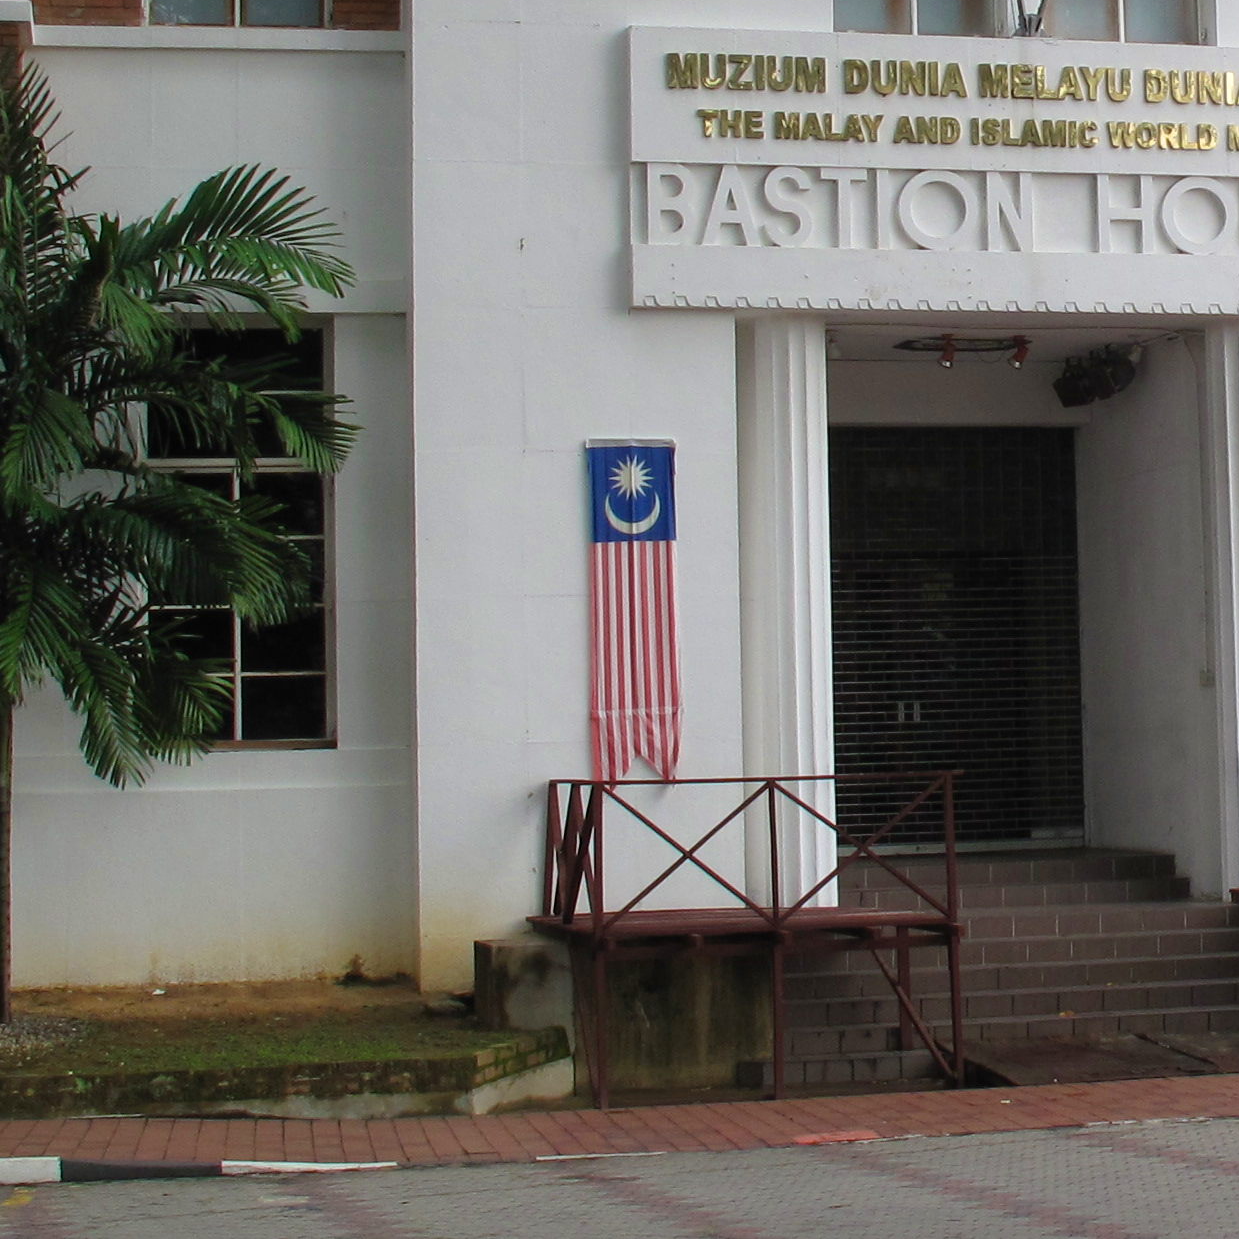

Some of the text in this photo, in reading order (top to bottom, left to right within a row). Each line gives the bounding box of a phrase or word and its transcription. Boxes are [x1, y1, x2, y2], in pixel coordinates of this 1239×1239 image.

[667, 53, 827, 93] MUZIUM
[844, 59, 967, 98] DUNIA
[979, 63, 1131, 101] MELAYU
[697, 108, 764, 139] THE
[775, 111, 884, 143] MALAY
[894, 115, 961, 145] AND
[971, 117, 1098, 148] ISLAMIC
[1107, 121, 1218, 151] WORLD
[647, 162, 1034, 253] BASTION
